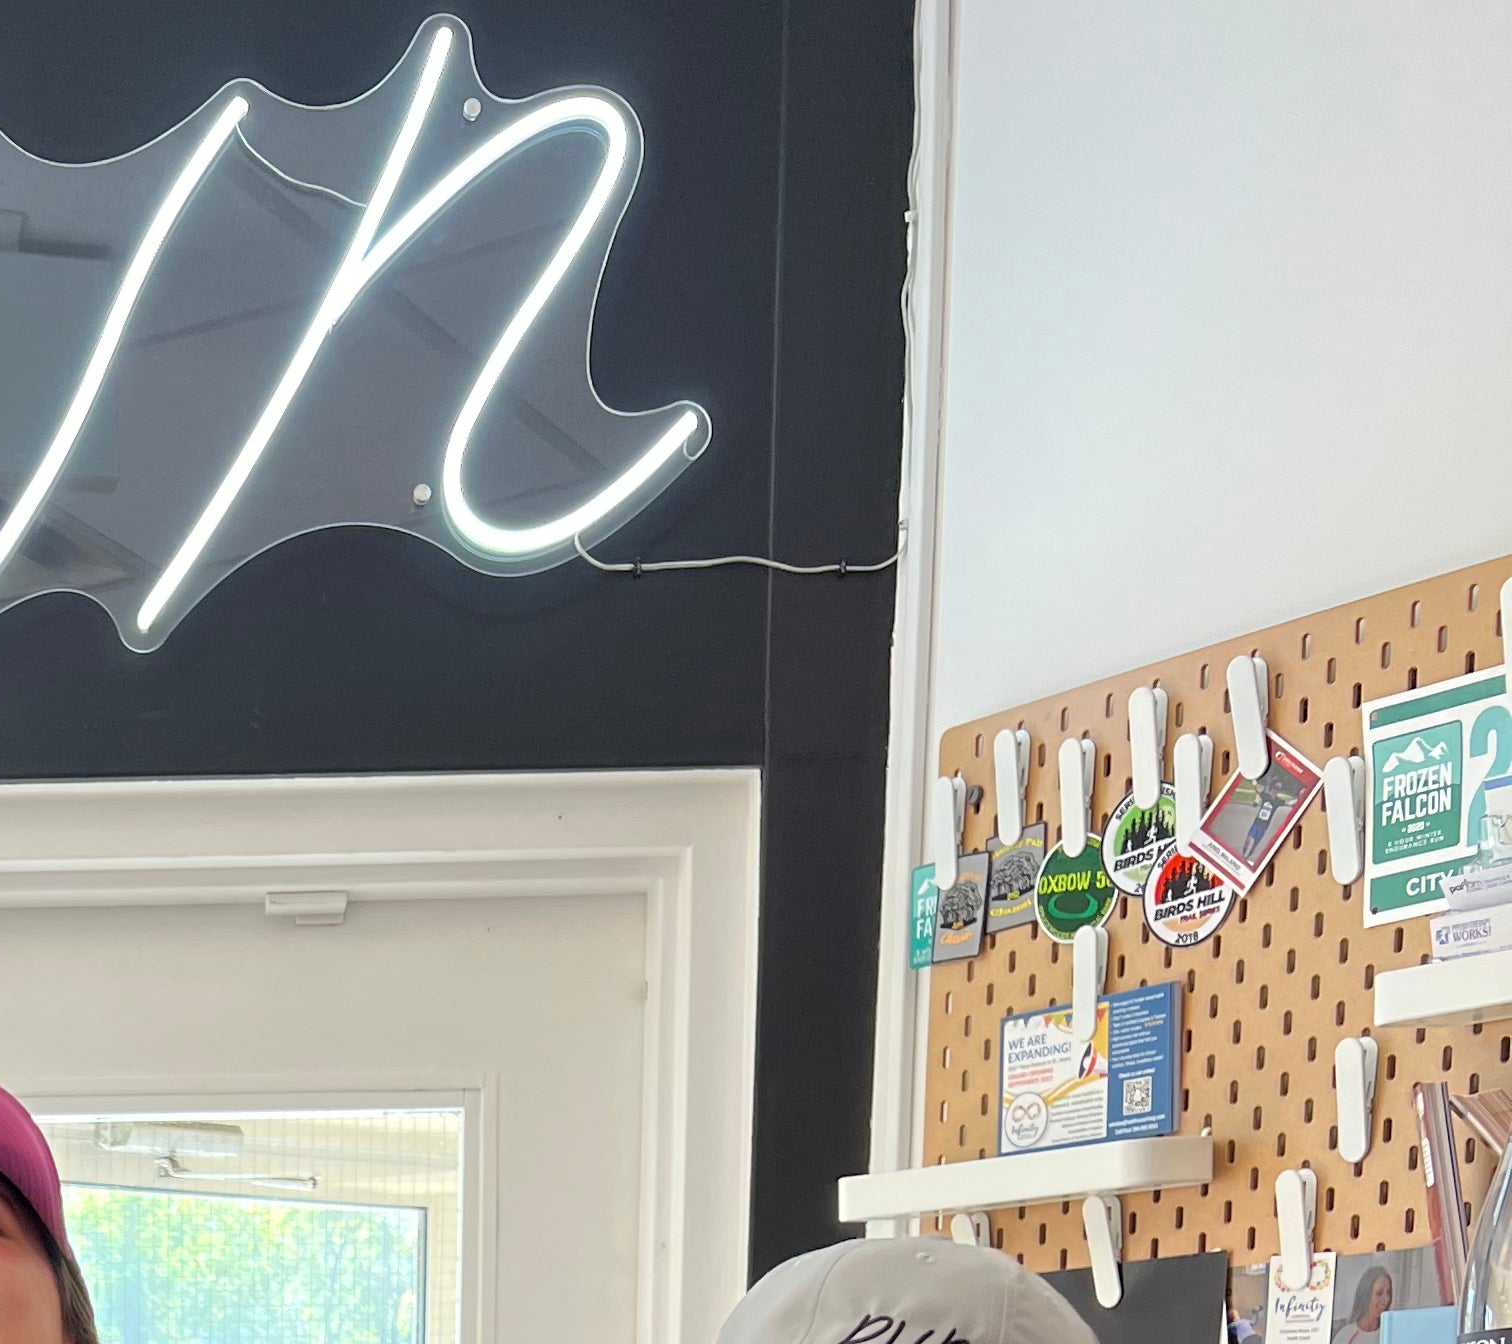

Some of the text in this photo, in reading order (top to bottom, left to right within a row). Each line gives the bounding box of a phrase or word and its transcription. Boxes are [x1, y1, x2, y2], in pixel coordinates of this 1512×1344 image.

[1383, 762, 1452, 801] FROZEN
[1382, 787, 1452, 826] FALCON
[1114, 848, 1154, 872] BIRDS
[1038, 870, 1092, 895] OXBOW
[1154, 890, 1225, 922] BIRDS HILL
[1008, 1033, 1047, 1050] WE ARE
[1008, 1041, 1071, 1064] EXPANDING!
[1275, 1295, 1326, 1321] Infinity
